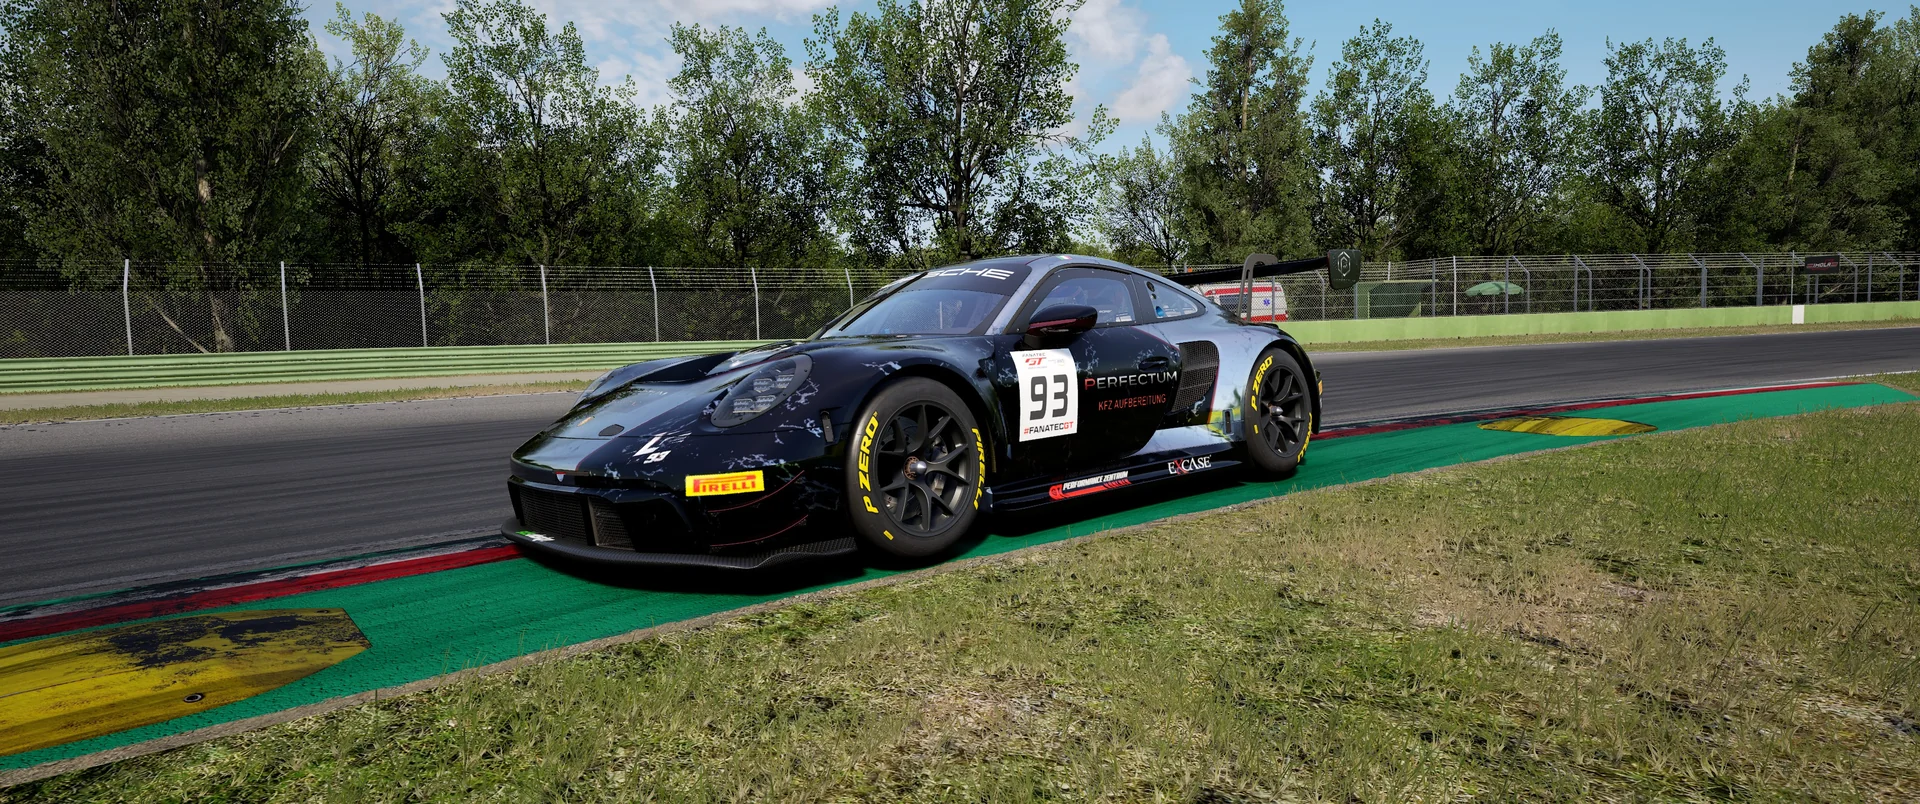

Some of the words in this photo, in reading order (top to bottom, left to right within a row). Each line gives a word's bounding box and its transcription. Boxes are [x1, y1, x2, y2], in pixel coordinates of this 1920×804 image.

[921, 268, 1015, 281] SCHE
[1025, 357, 1047, 366] GT
[1084, 371, 1178, 391] PERFECTUM
[1252, 356, 1273, 396] ZERO
[1029, 374, 1068, 420] 93
[1098, 400, 1113, 411] KFZ
[1114, 394, 1167, 409] AUFBEREITUNG
[1251, 395, 1258, 411] P
[1023, 421, 1074, 434] #FANATECGT
[643, 450, 671, 465] 93
[858, 413, 879, 491] ZERO
[971, 427, 986, 510] PIRELLI
[1167, 455, 1211, 475] EXCASE
[692, 474, 757, 493] PIRELLI
[1063, 475, 1104, 491] PERFORMANCE
[1103, 470, 1129, 482] ZENTRUM
[863, 495, 879, 514] P
